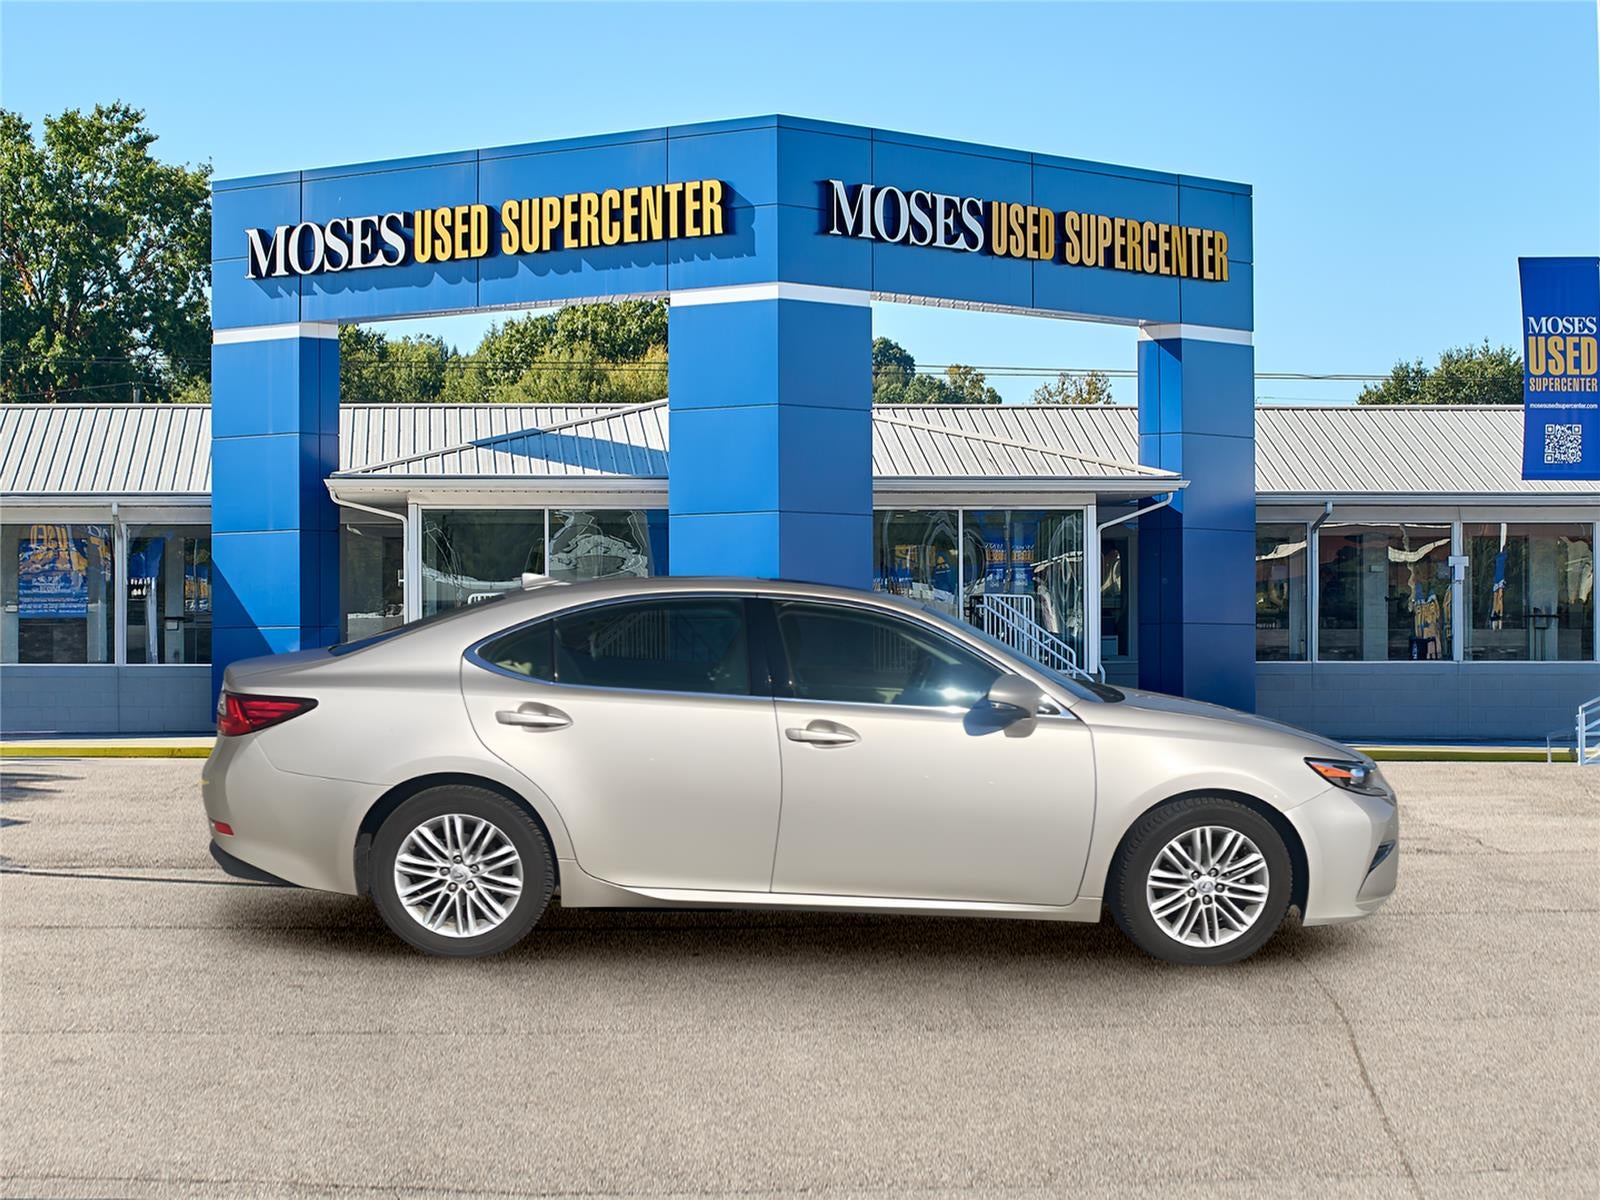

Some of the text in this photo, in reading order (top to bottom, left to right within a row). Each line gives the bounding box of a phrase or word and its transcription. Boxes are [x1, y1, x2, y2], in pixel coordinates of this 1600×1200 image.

[244, 179, 723, 280] MOSES USED SUPERCENTER
[829, 180, 1229, 282] MOSES USED SUPERCENTER
[1527, 316, 1597, 335] MOSES
[1528, 336, 1598, 376] USED
[1529, 377, 1598, 392] SUPERCENTER
